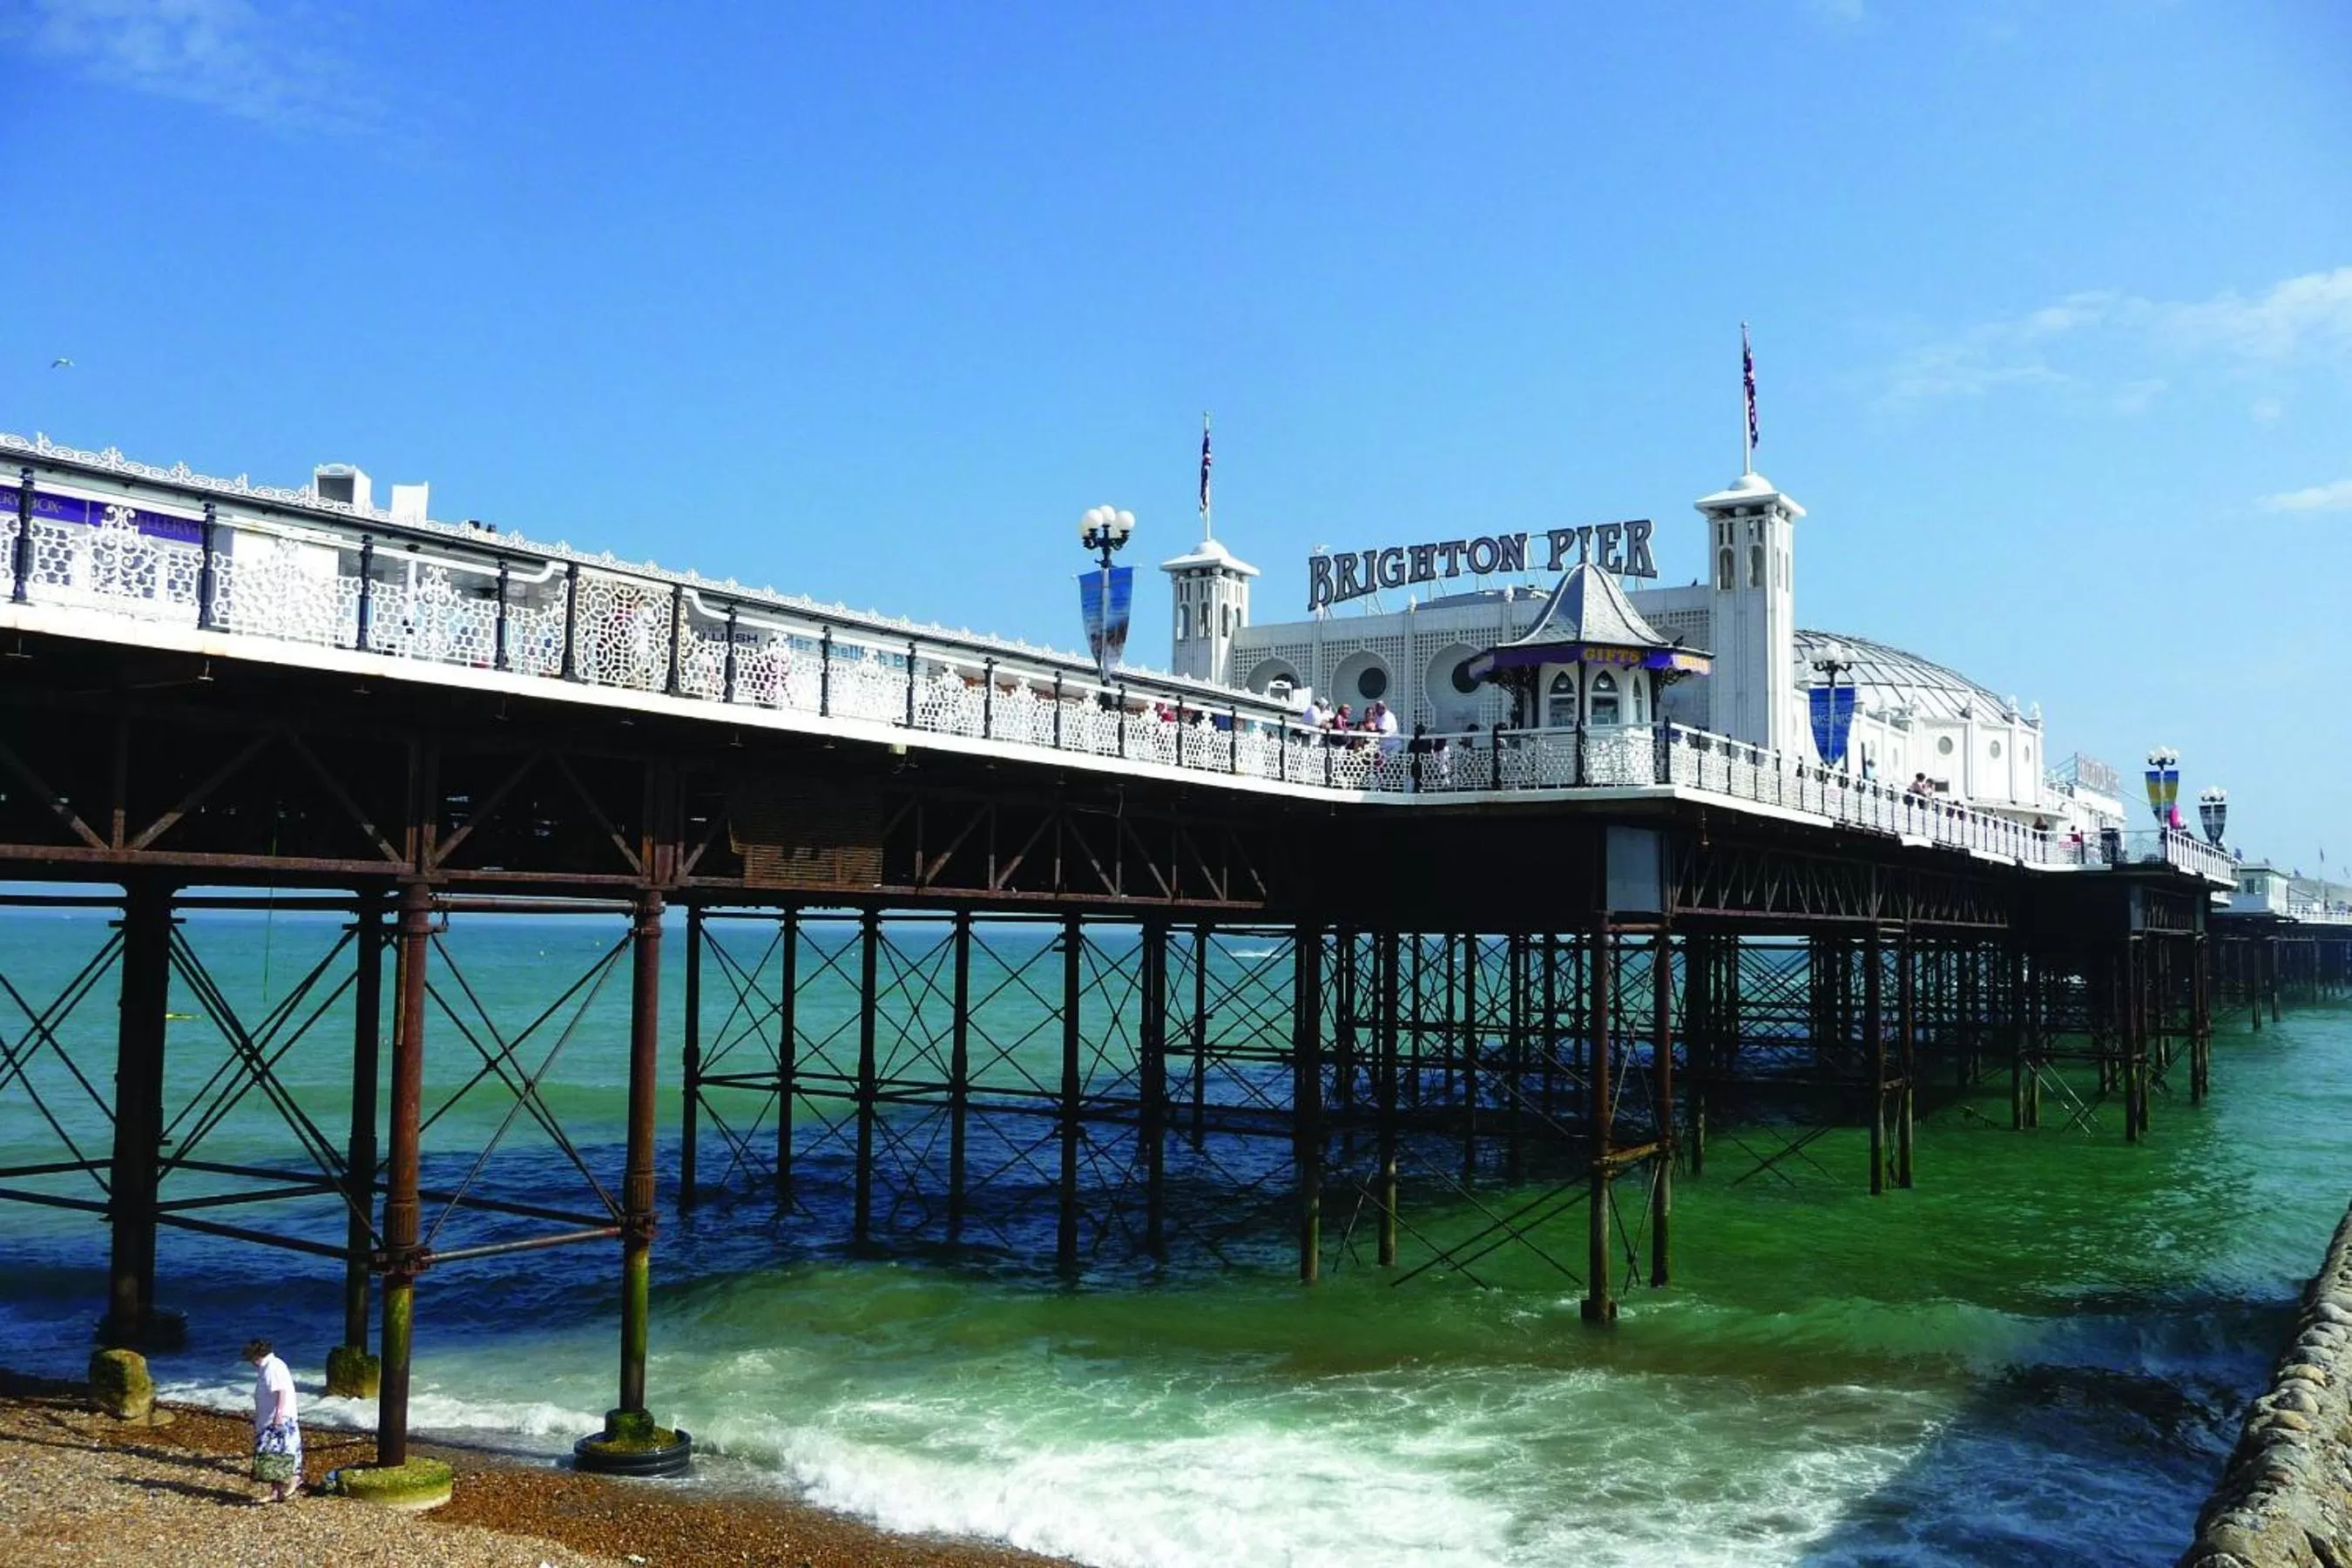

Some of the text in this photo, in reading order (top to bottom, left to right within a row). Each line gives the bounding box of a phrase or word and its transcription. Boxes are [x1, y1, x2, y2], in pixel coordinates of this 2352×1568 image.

[1308, 519, 1658, 612] BRIGHTON PIER
[1583, 647, 1640, 665] GIFTS
